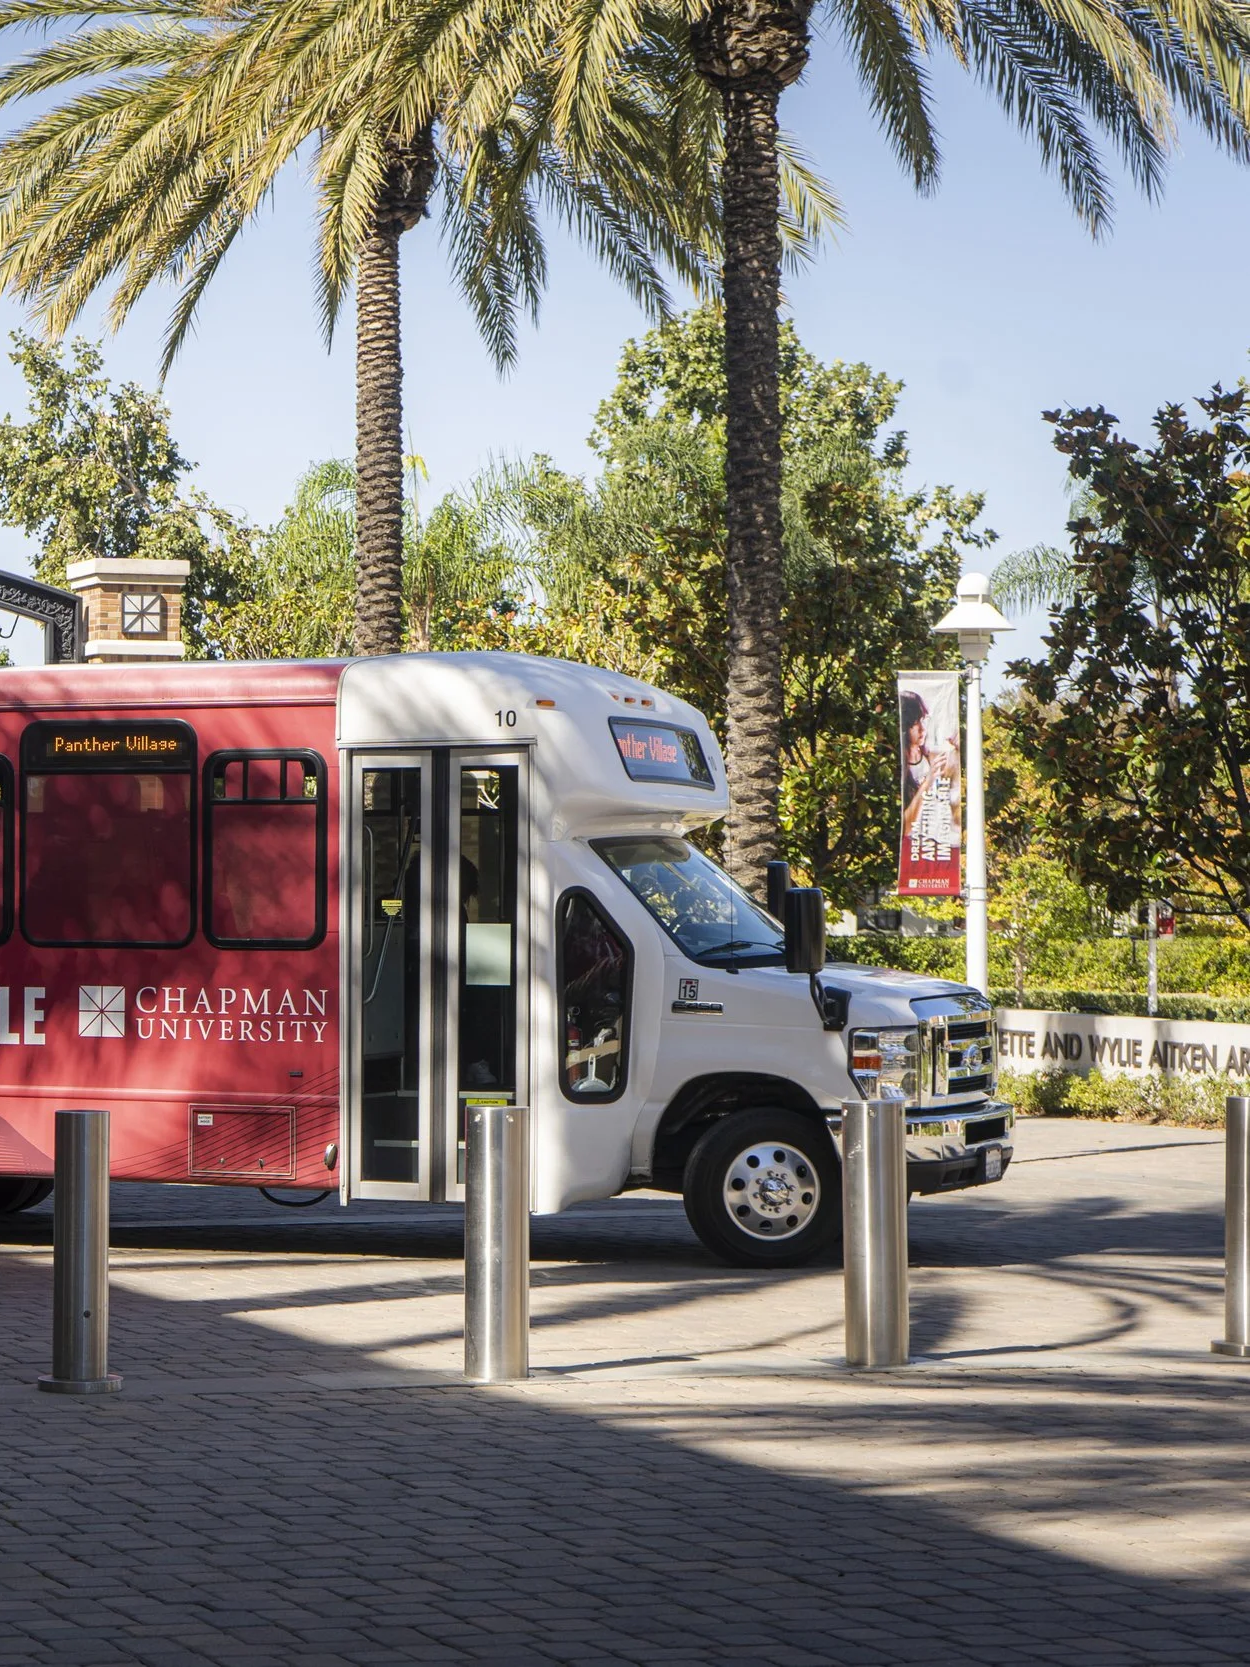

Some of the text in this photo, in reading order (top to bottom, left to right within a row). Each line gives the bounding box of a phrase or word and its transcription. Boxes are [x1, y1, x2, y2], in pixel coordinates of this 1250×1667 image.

[495, 710, 517, 728] 10
[55, 735, 177, 752] Panther Village
[910, 821, 921, 862] DREAM
[135, 986, 329, 1016] CHAPMAN
[682, 985, 696, 998] 15
[135, 1017, 329, 1043] UNIVERSITY
[1041, 1031, 1083, 1061] AND
[1088, 1034, 1143, 1069] WYLIE
[1149, 1039, 1218, 1074] AITKEN
